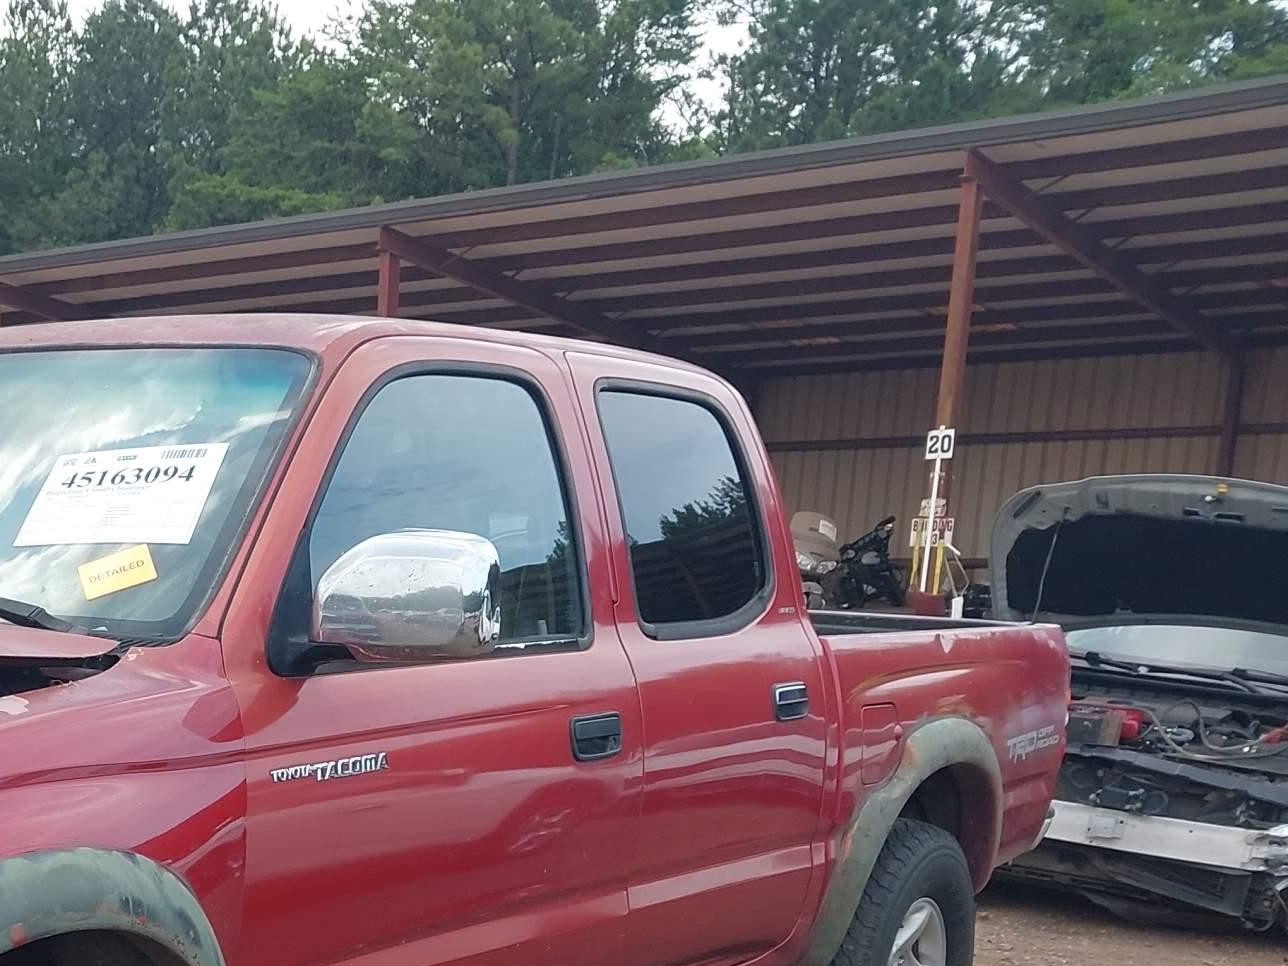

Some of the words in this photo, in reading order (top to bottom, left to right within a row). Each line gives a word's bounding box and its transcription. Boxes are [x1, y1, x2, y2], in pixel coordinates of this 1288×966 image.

[928, 435, 953, 454] 20
[62, 465, 196, 488] 45163094
[88, 559, 145, 584] DETAILED
[270, 764, 313, 783] TOYOTA
[312, 752, 388, 781] TACOMA
